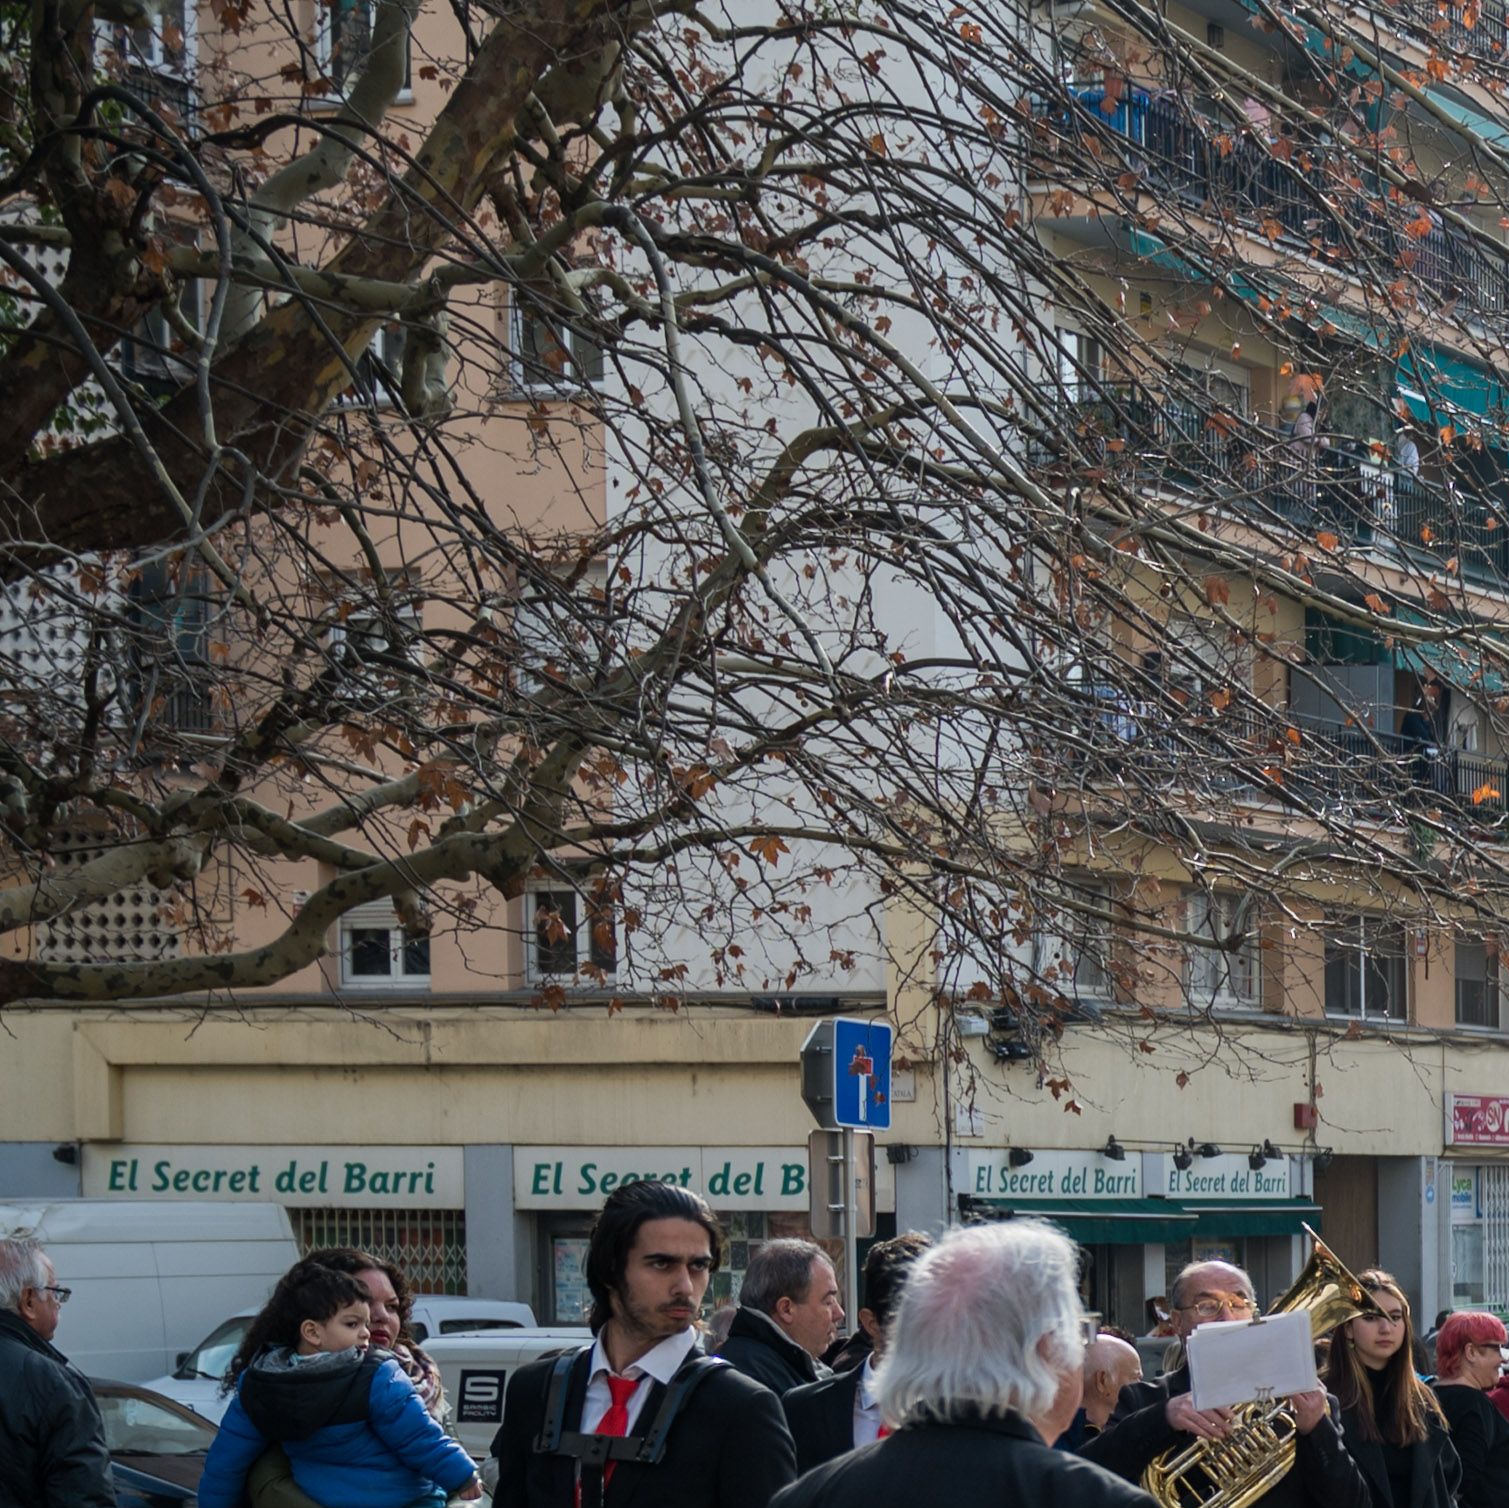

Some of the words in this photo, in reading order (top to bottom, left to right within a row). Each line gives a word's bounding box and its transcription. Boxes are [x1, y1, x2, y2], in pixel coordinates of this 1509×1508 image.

[107, 1159, 139, 1191] El
[151, 1160, 261, 1193] Secret
[274, 1161, 329, 1194] del
[342, 1162, 436, 1194] Barri
[531, 1161, 563, 1196] El
[708, 1161, 765, 1196] del
[975, 1165, 992, 1193] El
[998, 1166, 1054, 1195] Secret
[1061, 1167, 1087, 1195] del
[1094, 1168, 1137, 1195] Barri
[1168, 1170, 1181, 1193] El
[1186, 1170, 1227, 1194] Secret
[1230, 1169, 1250, 1194] del
[1254, 1170, 1287, 1194] Barri
[1452, 1175, 1472, 1194] Lyca
